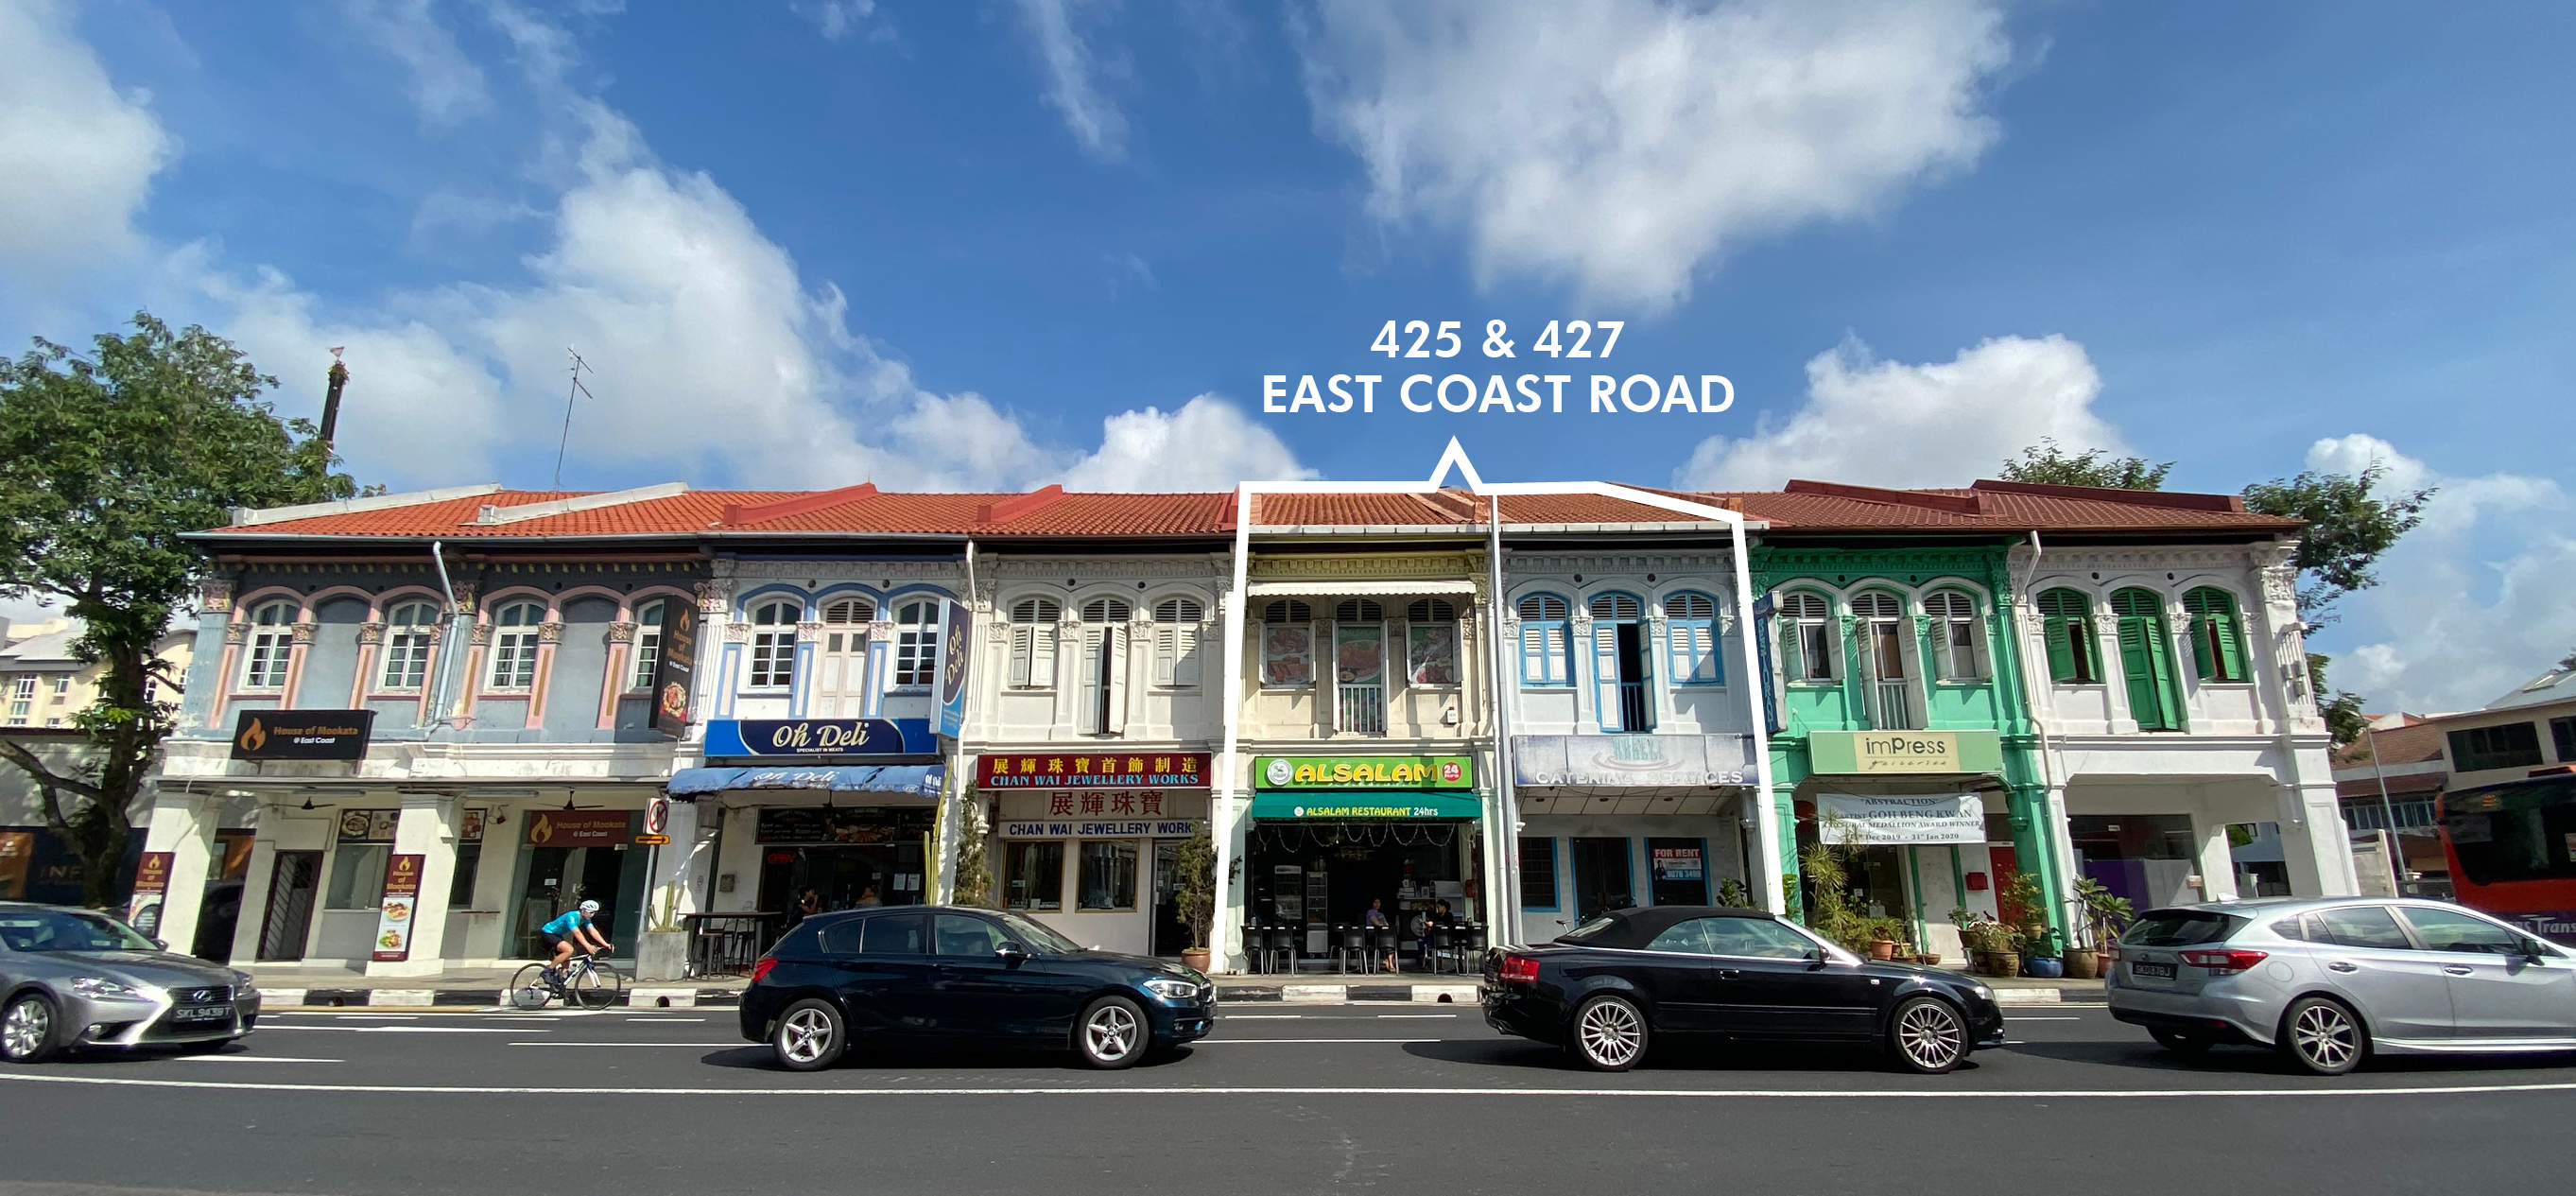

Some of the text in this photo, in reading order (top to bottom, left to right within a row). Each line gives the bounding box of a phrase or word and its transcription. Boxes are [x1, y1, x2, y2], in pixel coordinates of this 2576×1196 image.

[949, 624, 962, 655] Oh
[945, 646, 964, 685] Deli
[1758, 617, 1774, 731] RESTAURANT
[273, 726, 358, 736] House of Mookata
[772, 720, 870, 748] Oh Deli
[1294, 763, 1438, 783] ALSALAM
[1444, 764, 1460, 773] 24
[753, 771, 840, 782] Oh Deli
[991, 773, 1199, 786] CHAN WAI JEWELLERY WORKS
[1306, 806, 1439, 816] ALSALAM RESTAURANT 24hrs
[1868, 809, 1893, 819] GOH
[1900, 809, 1933, 819] BENG
[1936, 809, 1973, 819] KWAN
[556, 821, 627, 829] House of Mookata
[1009, 822, 1193, 835] CHAN WAI JEWELLERY WORK
[1654, 848, 1700, 858] FOR RENT
